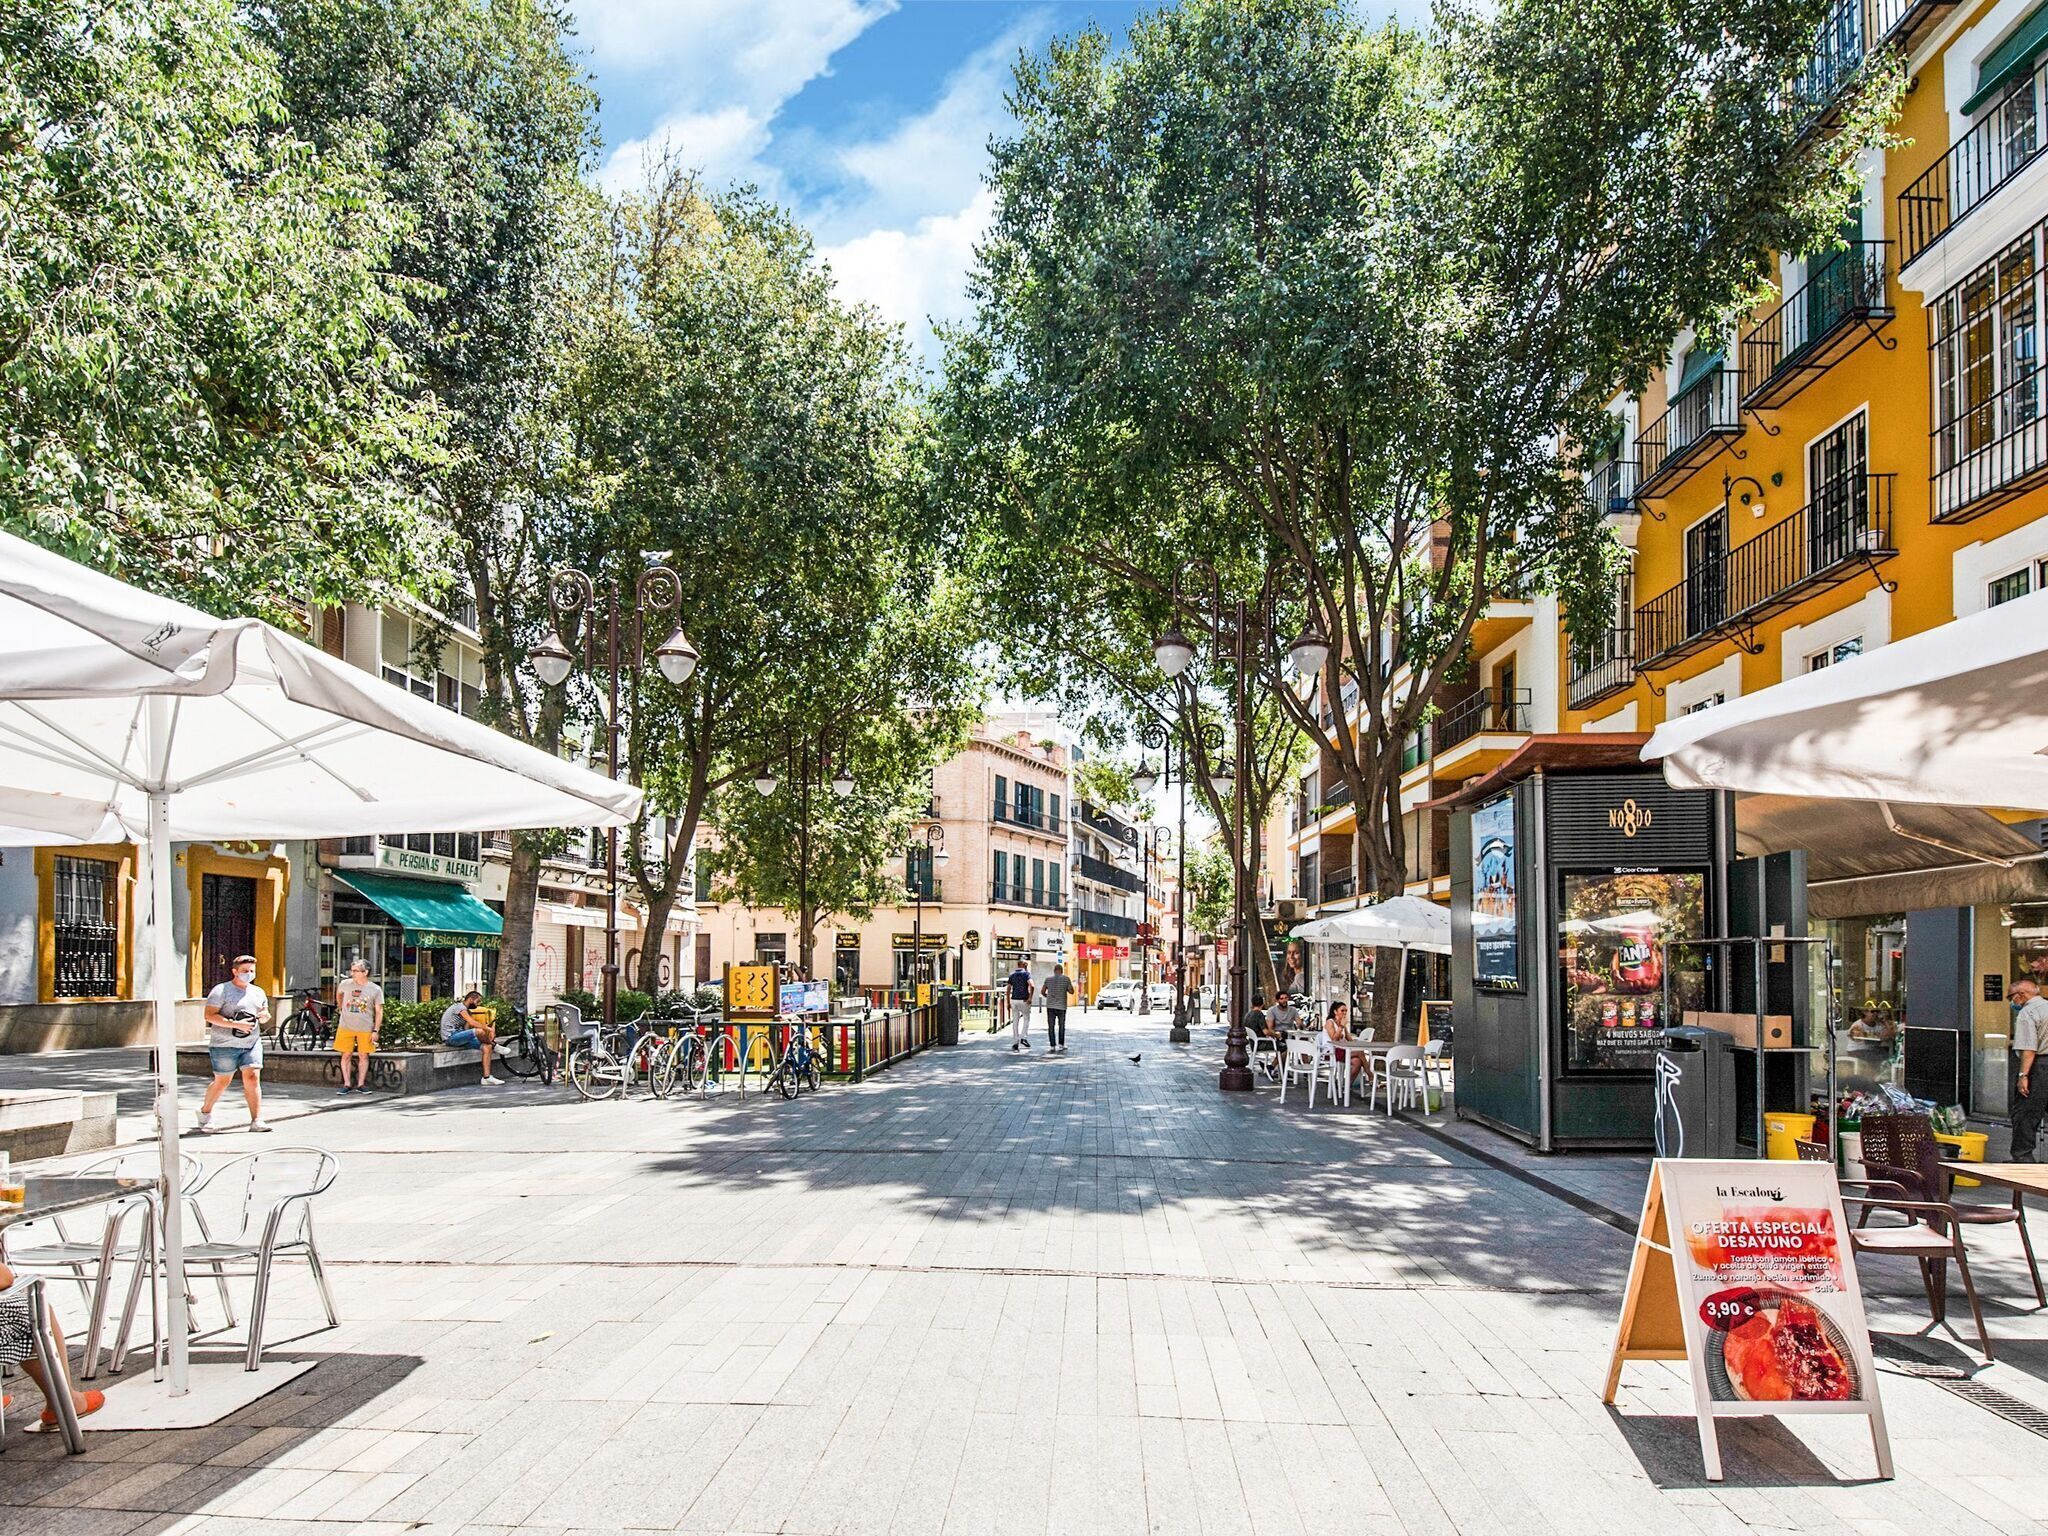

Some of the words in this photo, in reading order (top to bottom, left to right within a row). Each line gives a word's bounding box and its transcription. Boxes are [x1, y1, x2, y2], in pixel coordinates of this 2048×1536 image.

[399, 853, 440, 872] PERSIANAS
[445, 861, 479, 878] ALFALFA
[416, 932, 469, 947] Persianas
[1619, 944, 1651, 961] FANTA
[1606, 1030, 1611, 1038] 4
[1612, 1030, 1638, 1039] NUEVOS
[1639, 1030, 1661, 1038] SABOR
[1716, 1186, 1727, 1197] la
[1692, 1221, 1751, 1235] OFERTA
[1753, 1222, 1825, 1235] ESPECIAL
[1718, 1236, 1803, 1248] DESAYUNO
[1772, 1255, 1798, 1264] jamón
[1713, 1263, 1719, 1272] y
[1720, 1262, 1745, 1270] aceite
[1746, 1262, 1758, 1270] de
[1759, 1262, 1779, 1270] oliva
[1780, 1263, 1806, 1272] virgen
[1693, 1273, 1717, 1281] Zumo
[1718, 1273, 1728, 1281] de
[1730, 1273, 1762, 1283] naranja
[1763, 1273, 1789, 1281] recién
[1791, 1273, 1831, 1283] exprimido
[1814, 1285, 1834, 1293] Café
[1706, 1302, 1740, 1318] 3,90
[1744, 1306, 1754, 1316] €
